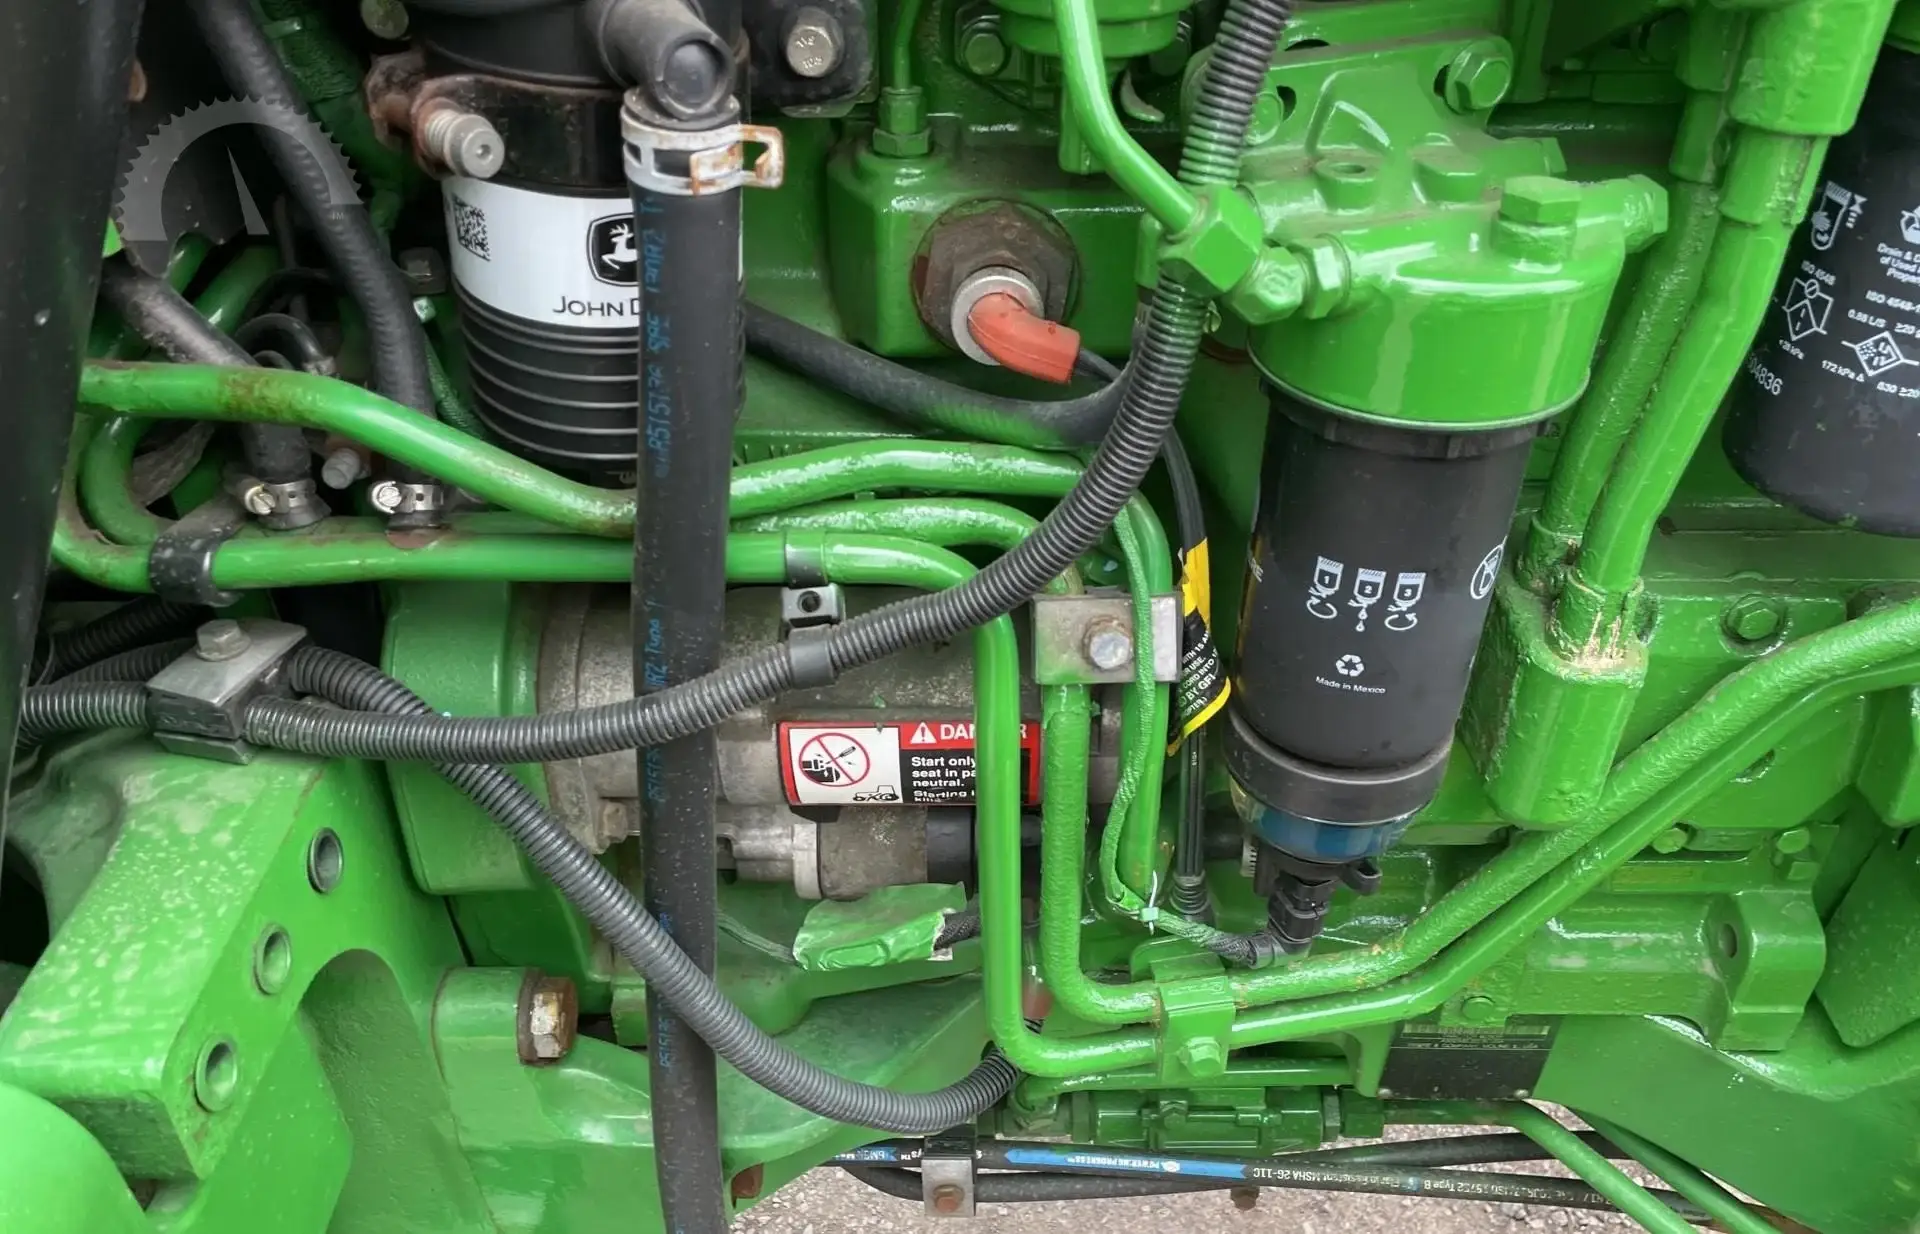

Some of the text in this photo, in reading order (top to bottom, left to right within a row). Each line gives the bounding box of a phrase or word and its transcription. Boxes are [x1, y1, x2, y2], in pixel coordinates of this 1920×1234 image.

[553, 296, 624, 317] JOHN
[1315, 675, 1386, 694] Made in Mexico
[1185, 686, 1200, 701] BY
[911, 755, 976, 768] Start only
[912, 769, 942, 778] seat
[945, 768, 958, 777] in
[912, 778, 965, 787] neutral.
[1292, 1170, 1321, 1182] MSHA
